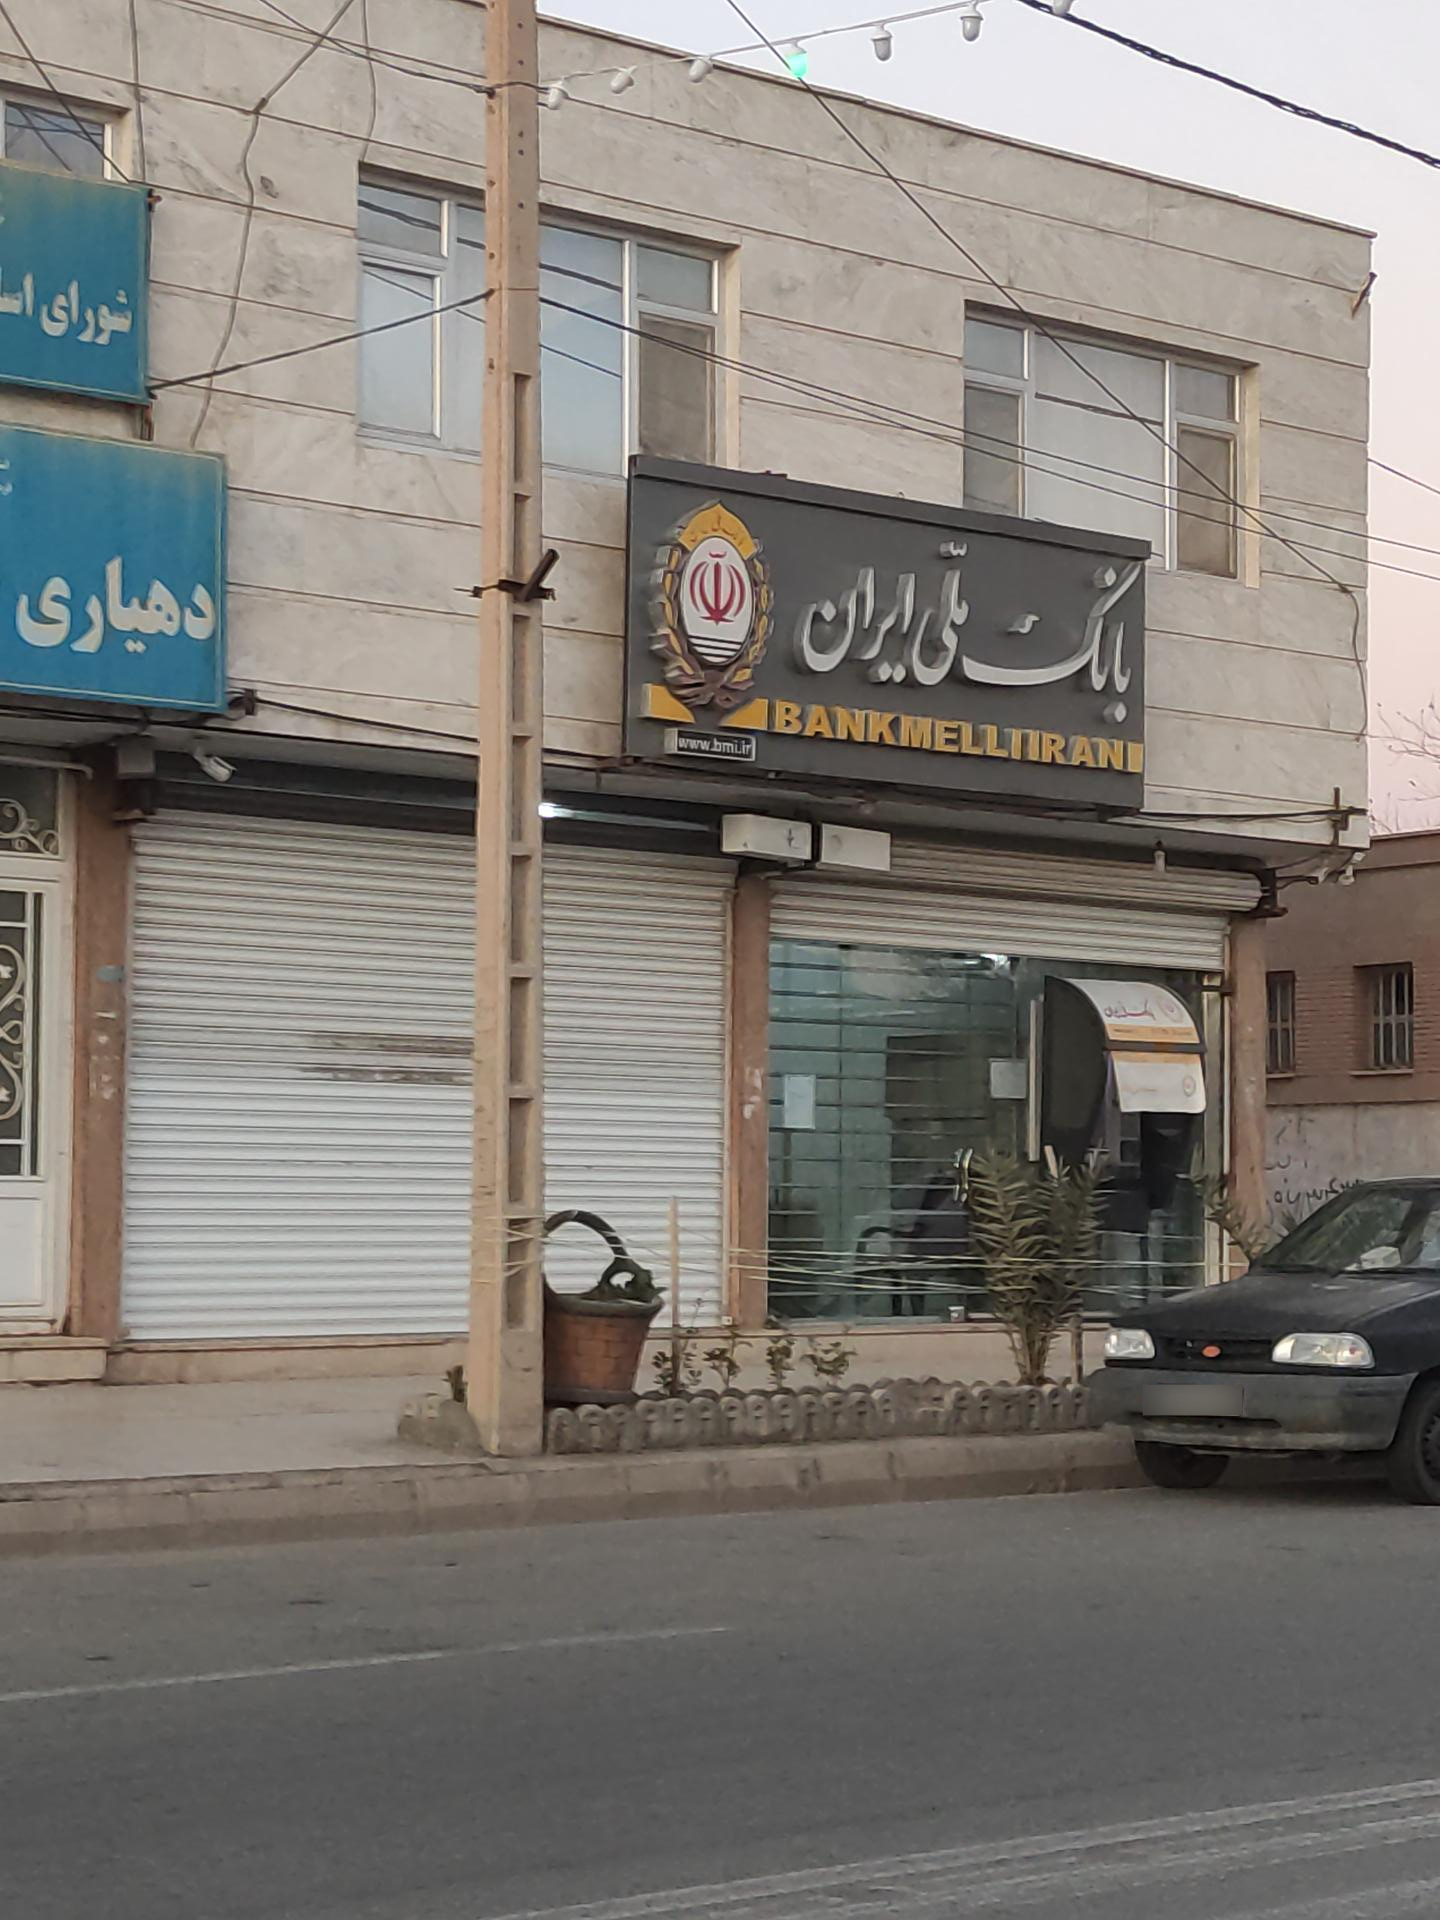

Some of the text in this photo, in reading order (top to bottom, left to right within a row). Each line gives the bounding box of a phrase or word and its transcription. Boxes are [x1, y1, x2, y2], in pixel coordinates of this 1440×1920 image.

[41, 279, 133, 346] شورای
[16, 557, 216, 653] دهیاری
[795, 566, 917, 684] ایران
[963, 562, 1144, 724] بانک
[678, 737, 753, 756] www.bmi.ir
[775, 700, 902, 745] BANK
